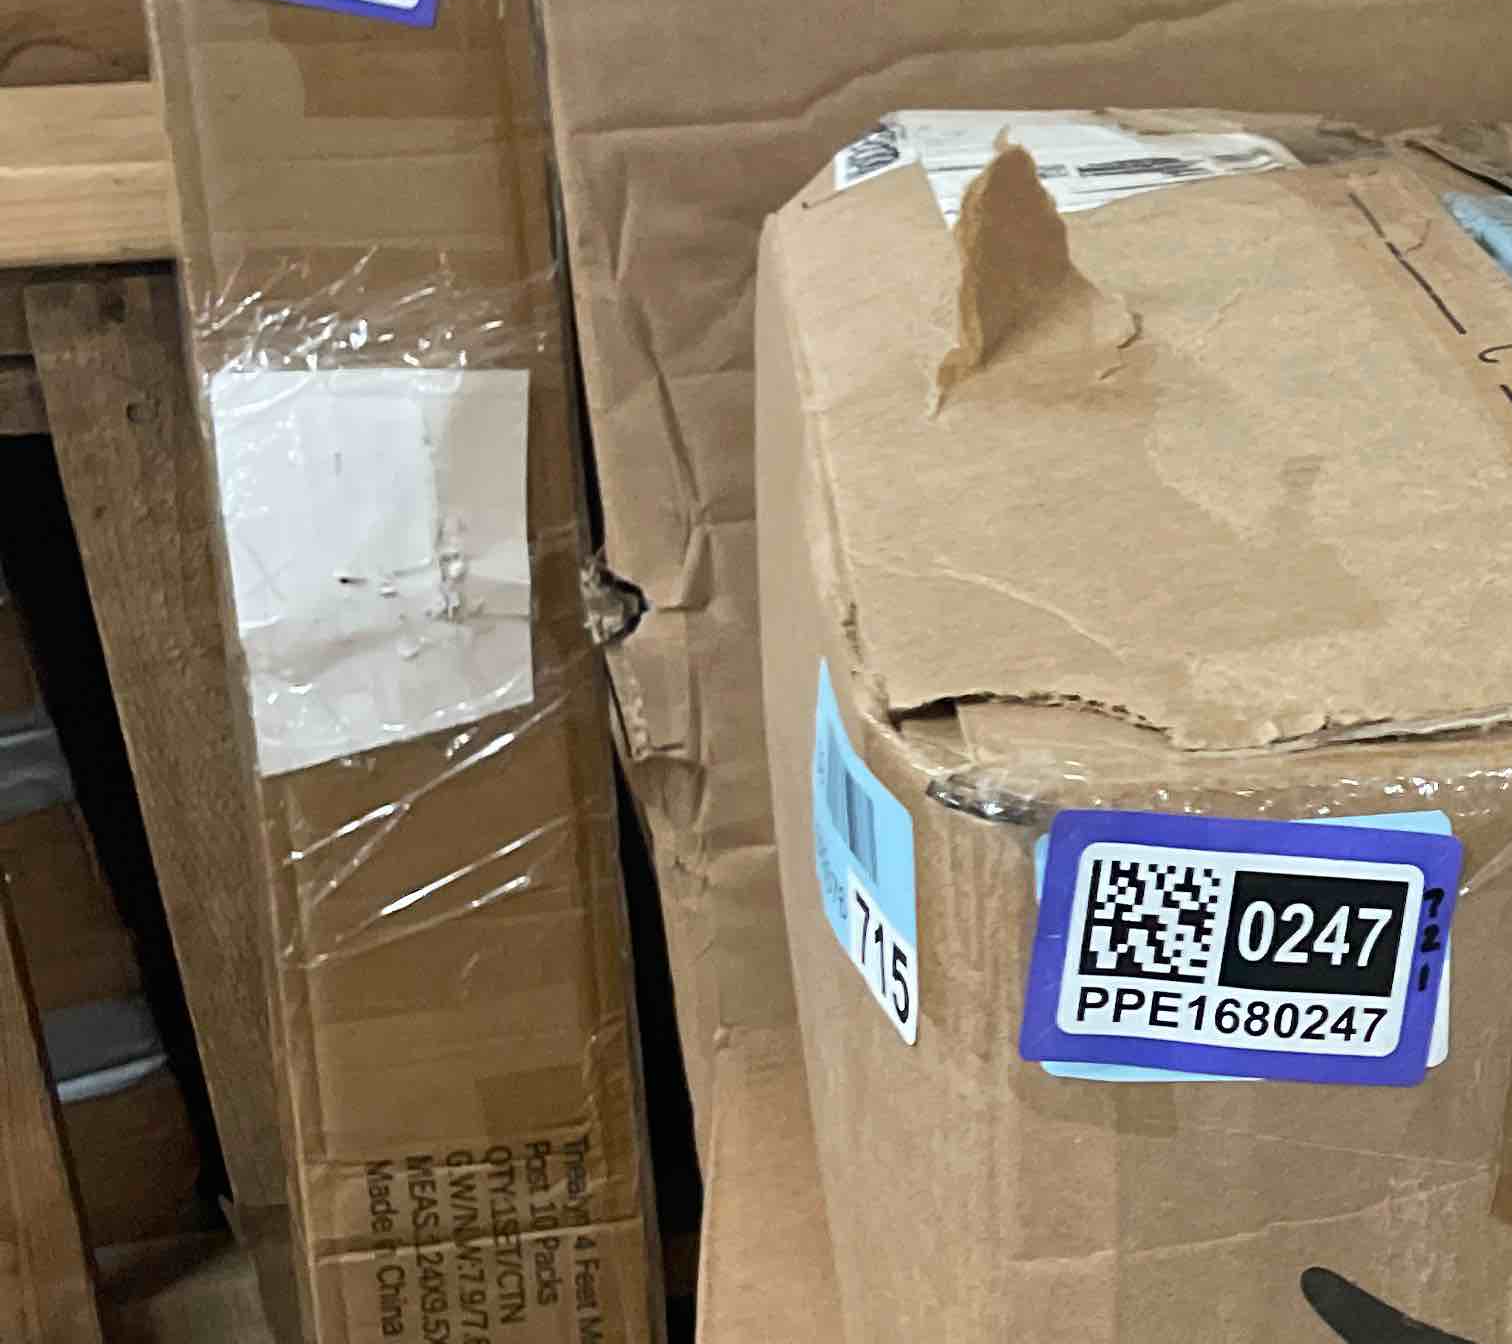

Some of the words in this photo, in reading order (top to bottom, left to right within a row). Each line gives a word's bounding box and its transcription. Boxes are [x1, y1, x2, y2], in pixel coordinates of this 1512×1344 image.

[855, 890, 910, 1025] 715
[1237, 899, 1394, 968] 0247
[1075, 985, 1388, 1044] PPE1680247
[368, 1160, 398, 1233] Made
[376, 1265, 406, 1337] China
